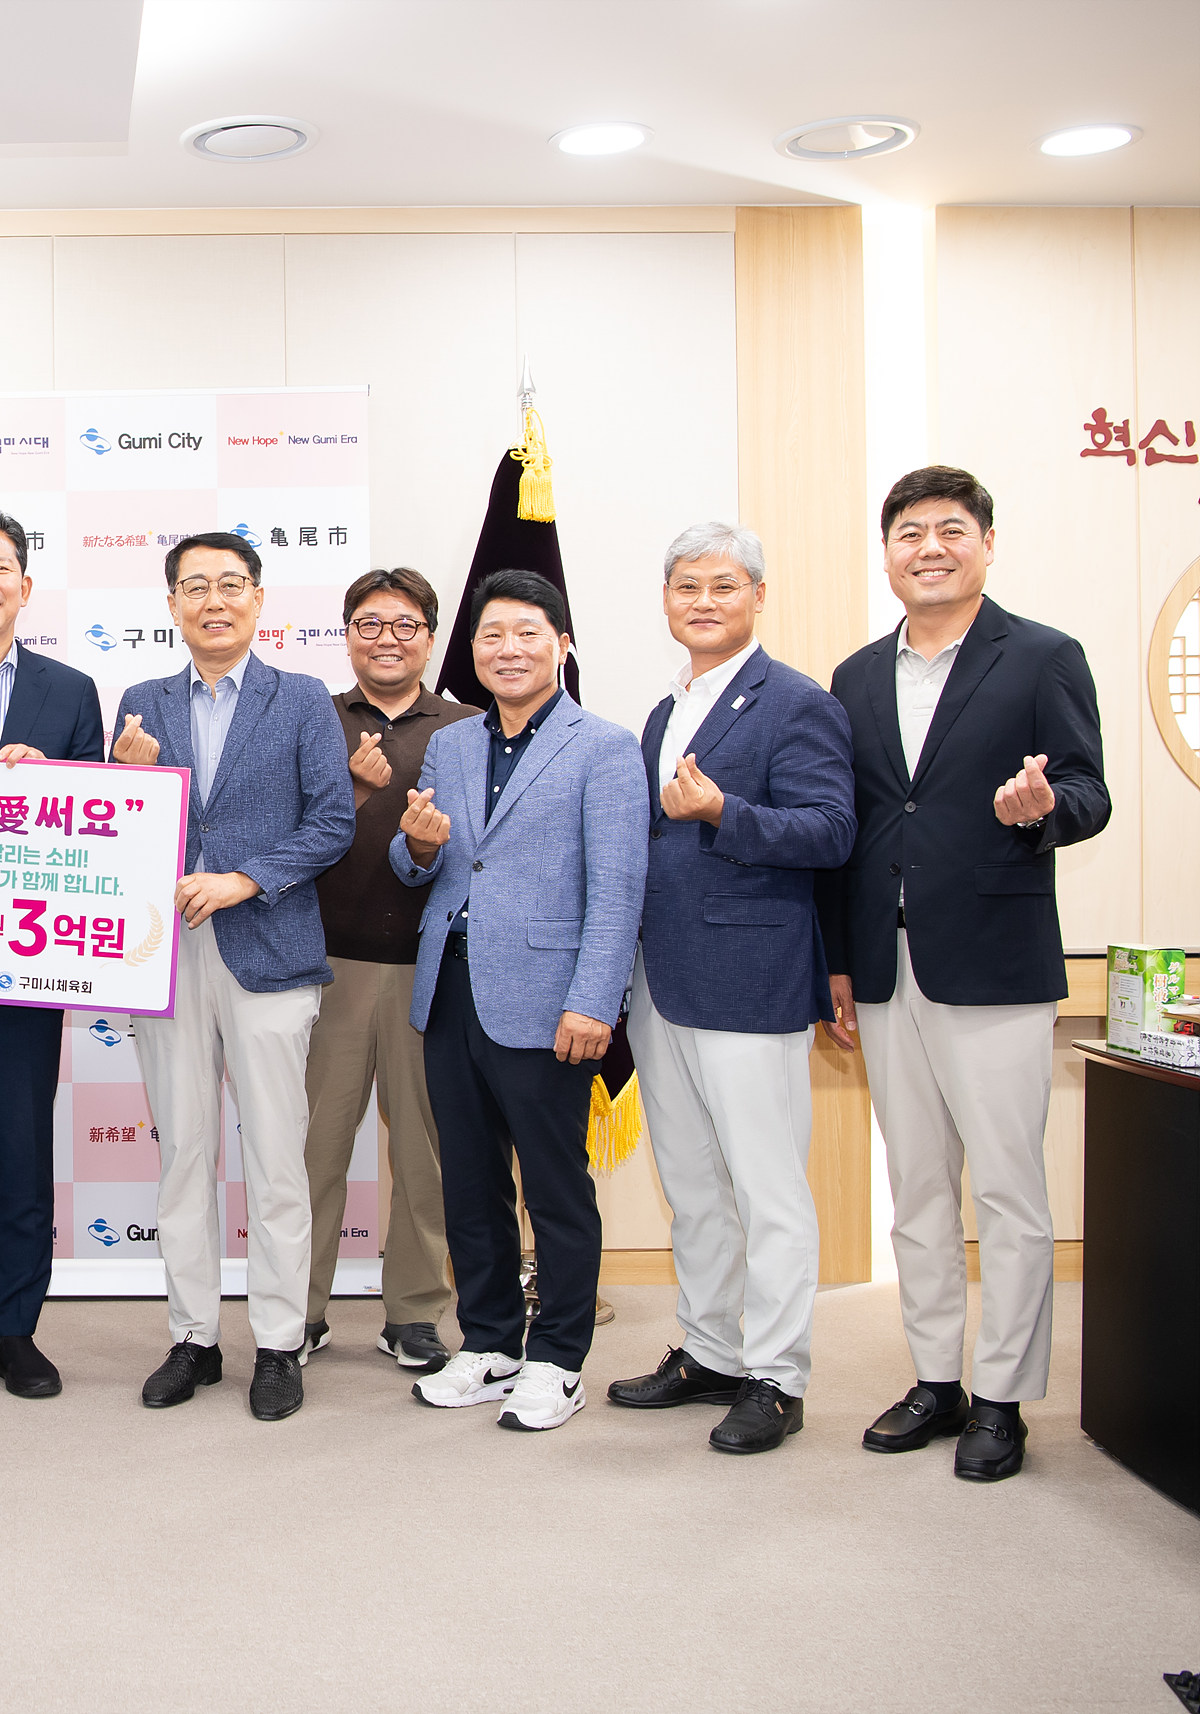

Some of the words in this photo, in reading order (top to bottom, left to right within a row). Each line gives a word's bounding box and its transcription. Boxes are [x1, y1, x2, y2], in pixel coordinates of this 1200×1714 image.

[19, 437, 49, 449] 시대
[118, 433, 162, 450] Gumi
[168, 432, 203, 451] City
[228, 436, 249, 446] New
[252, 436, 278, 448] Hope
[288, 435, 310, 445] New
[312, 434, 338, 445] Gumi
[340, 434, 358, 444] Era
[1080, 407, 1199, 466] 혁신
[157, 533, 199, 547] 亀尾
[270, 525, 348, 547] 亀尾市
[14, 636, 37, 646] umi
[40, 635, 57, 645] Era
[122, 628, 185, 649] 구미
[258, 629, 285, 650] 희망
[45, 847, 89, 869] 소비!
[22, 870, 59, 892] 함께
[64, 874, 124, 896] 합니다.
[18, 976, 93, 994] 구미시체육회
[89, 1126, 137, 1143] 新希望
[350, 1227, 369, 1238] Era
